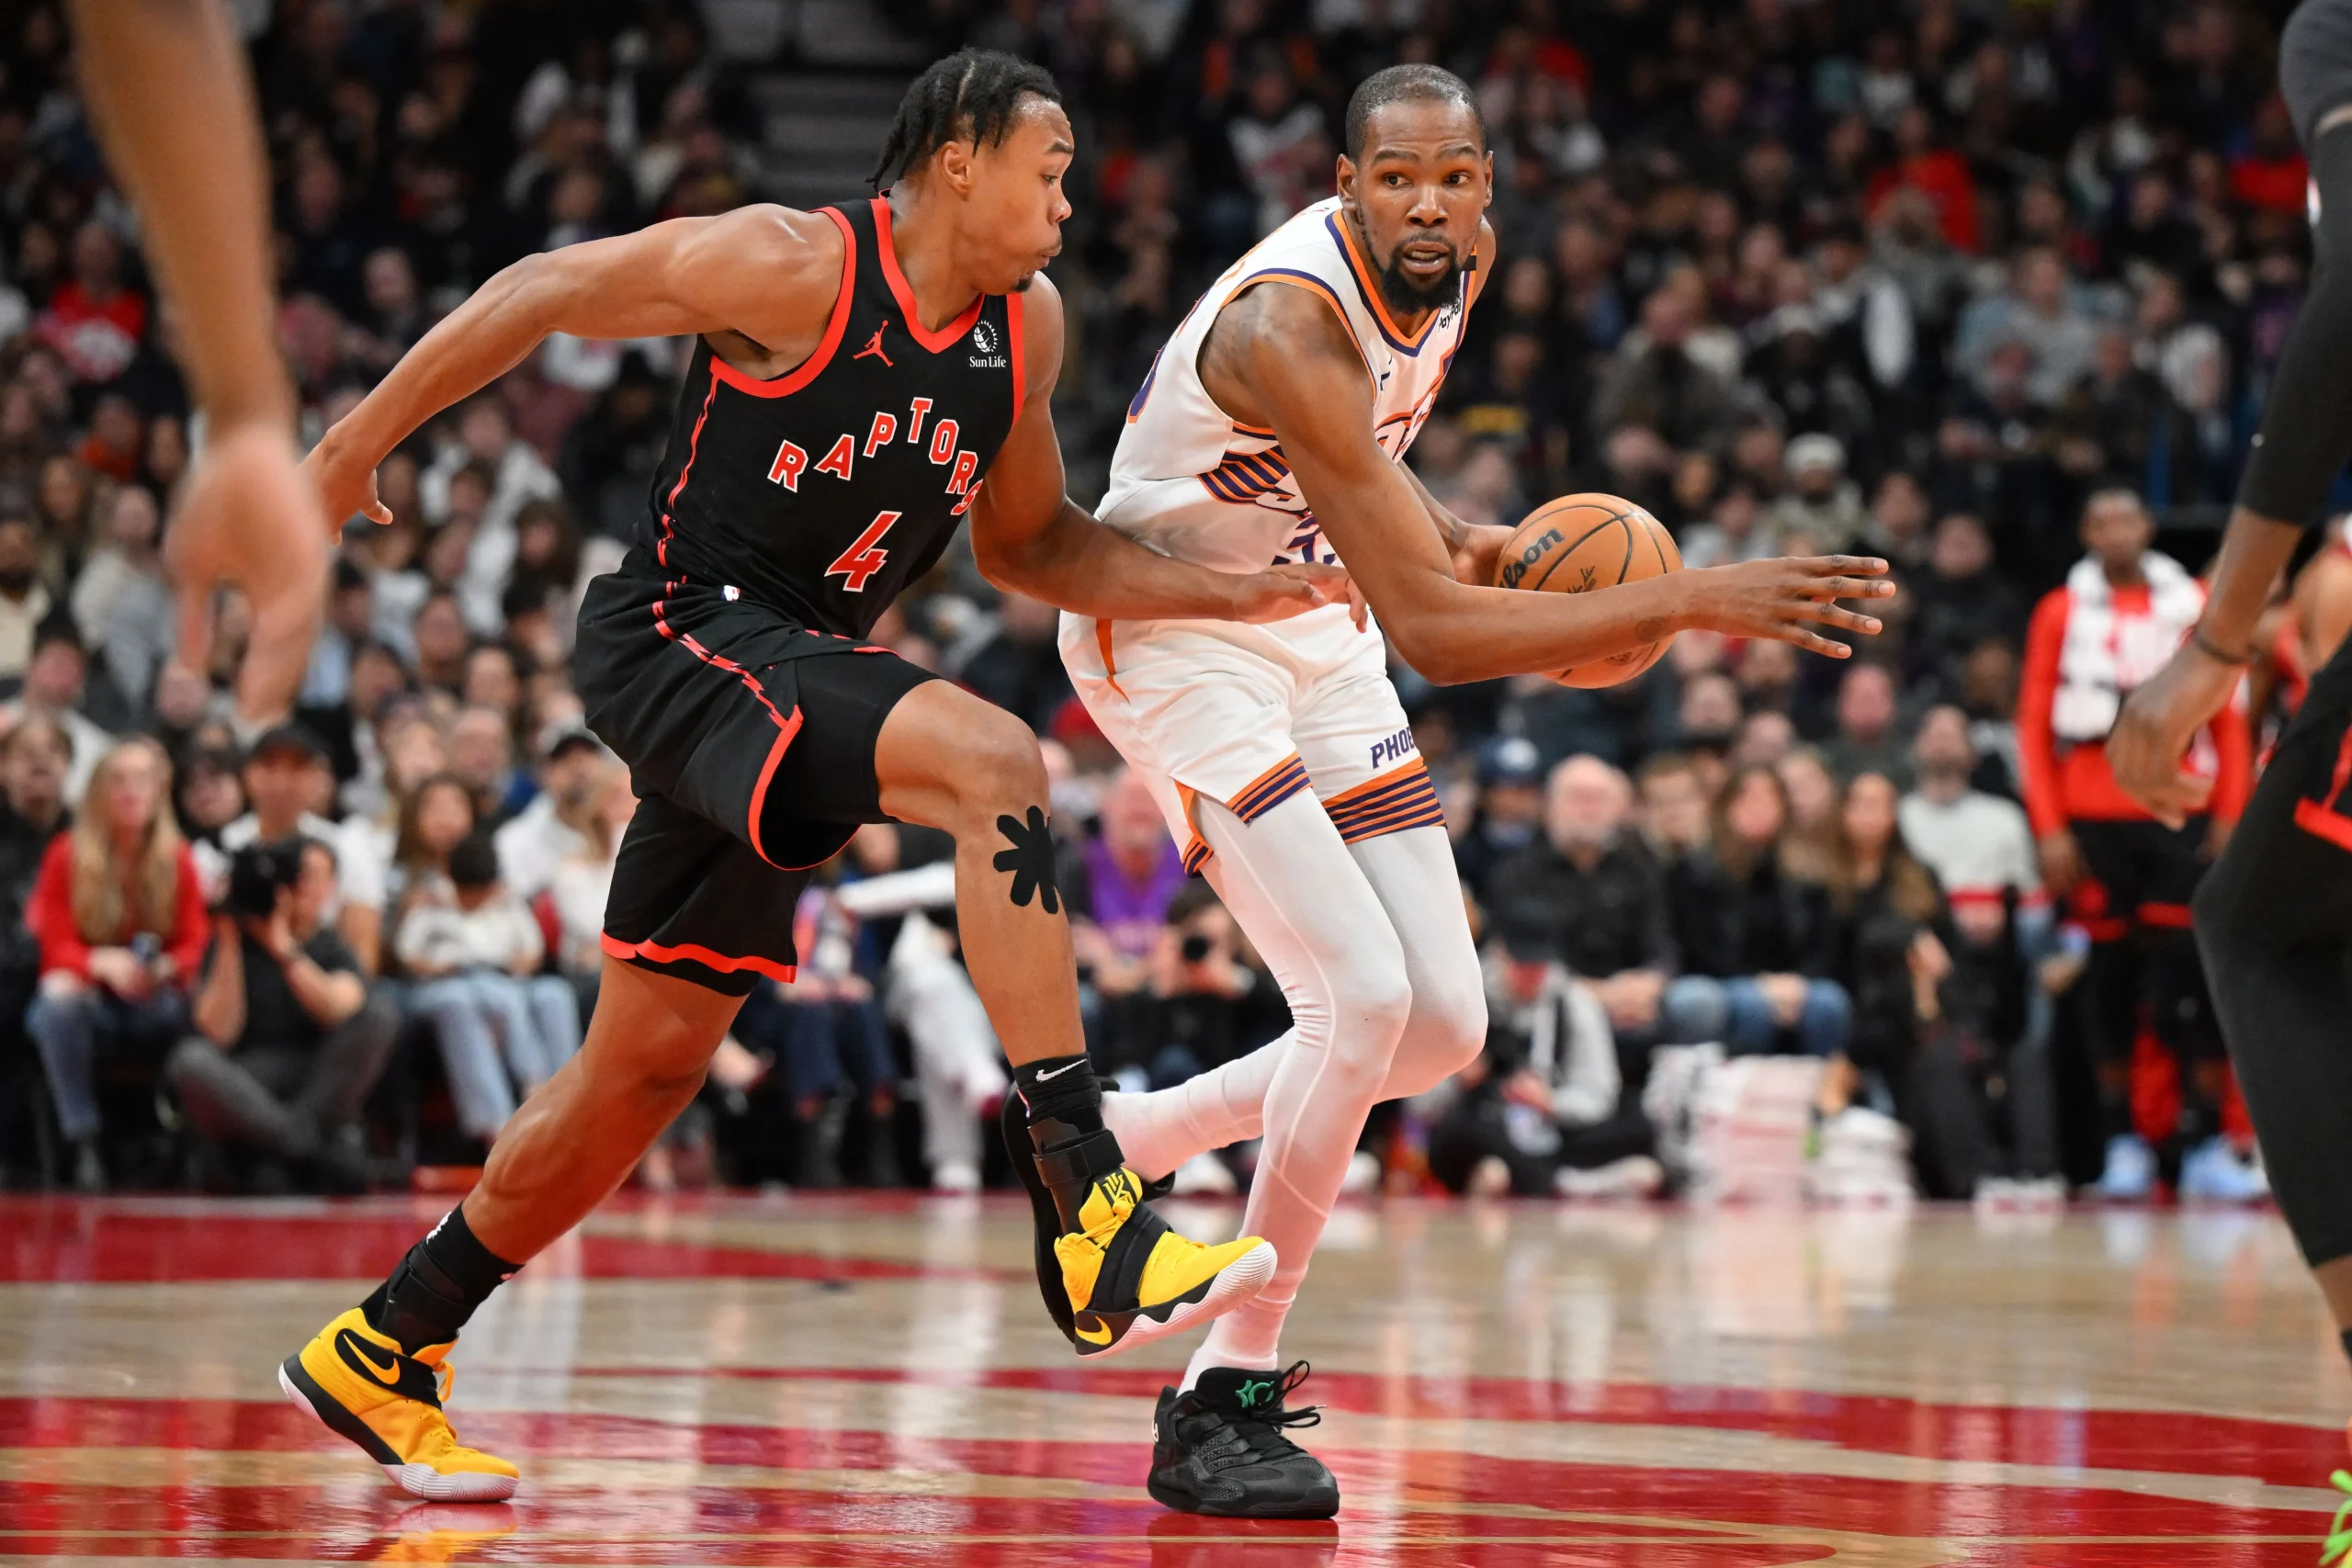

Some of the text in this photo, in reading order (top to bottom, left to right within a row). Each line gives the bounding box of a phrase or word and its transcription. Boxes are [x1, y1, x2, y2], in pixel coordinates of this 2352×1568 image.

[969, 355, 1007, 367] Sun Life
[767, 396, 984, 516] RAPTORS
[824, 510, 903, 592] 4
[1498, 527, 1566, 589] lson
